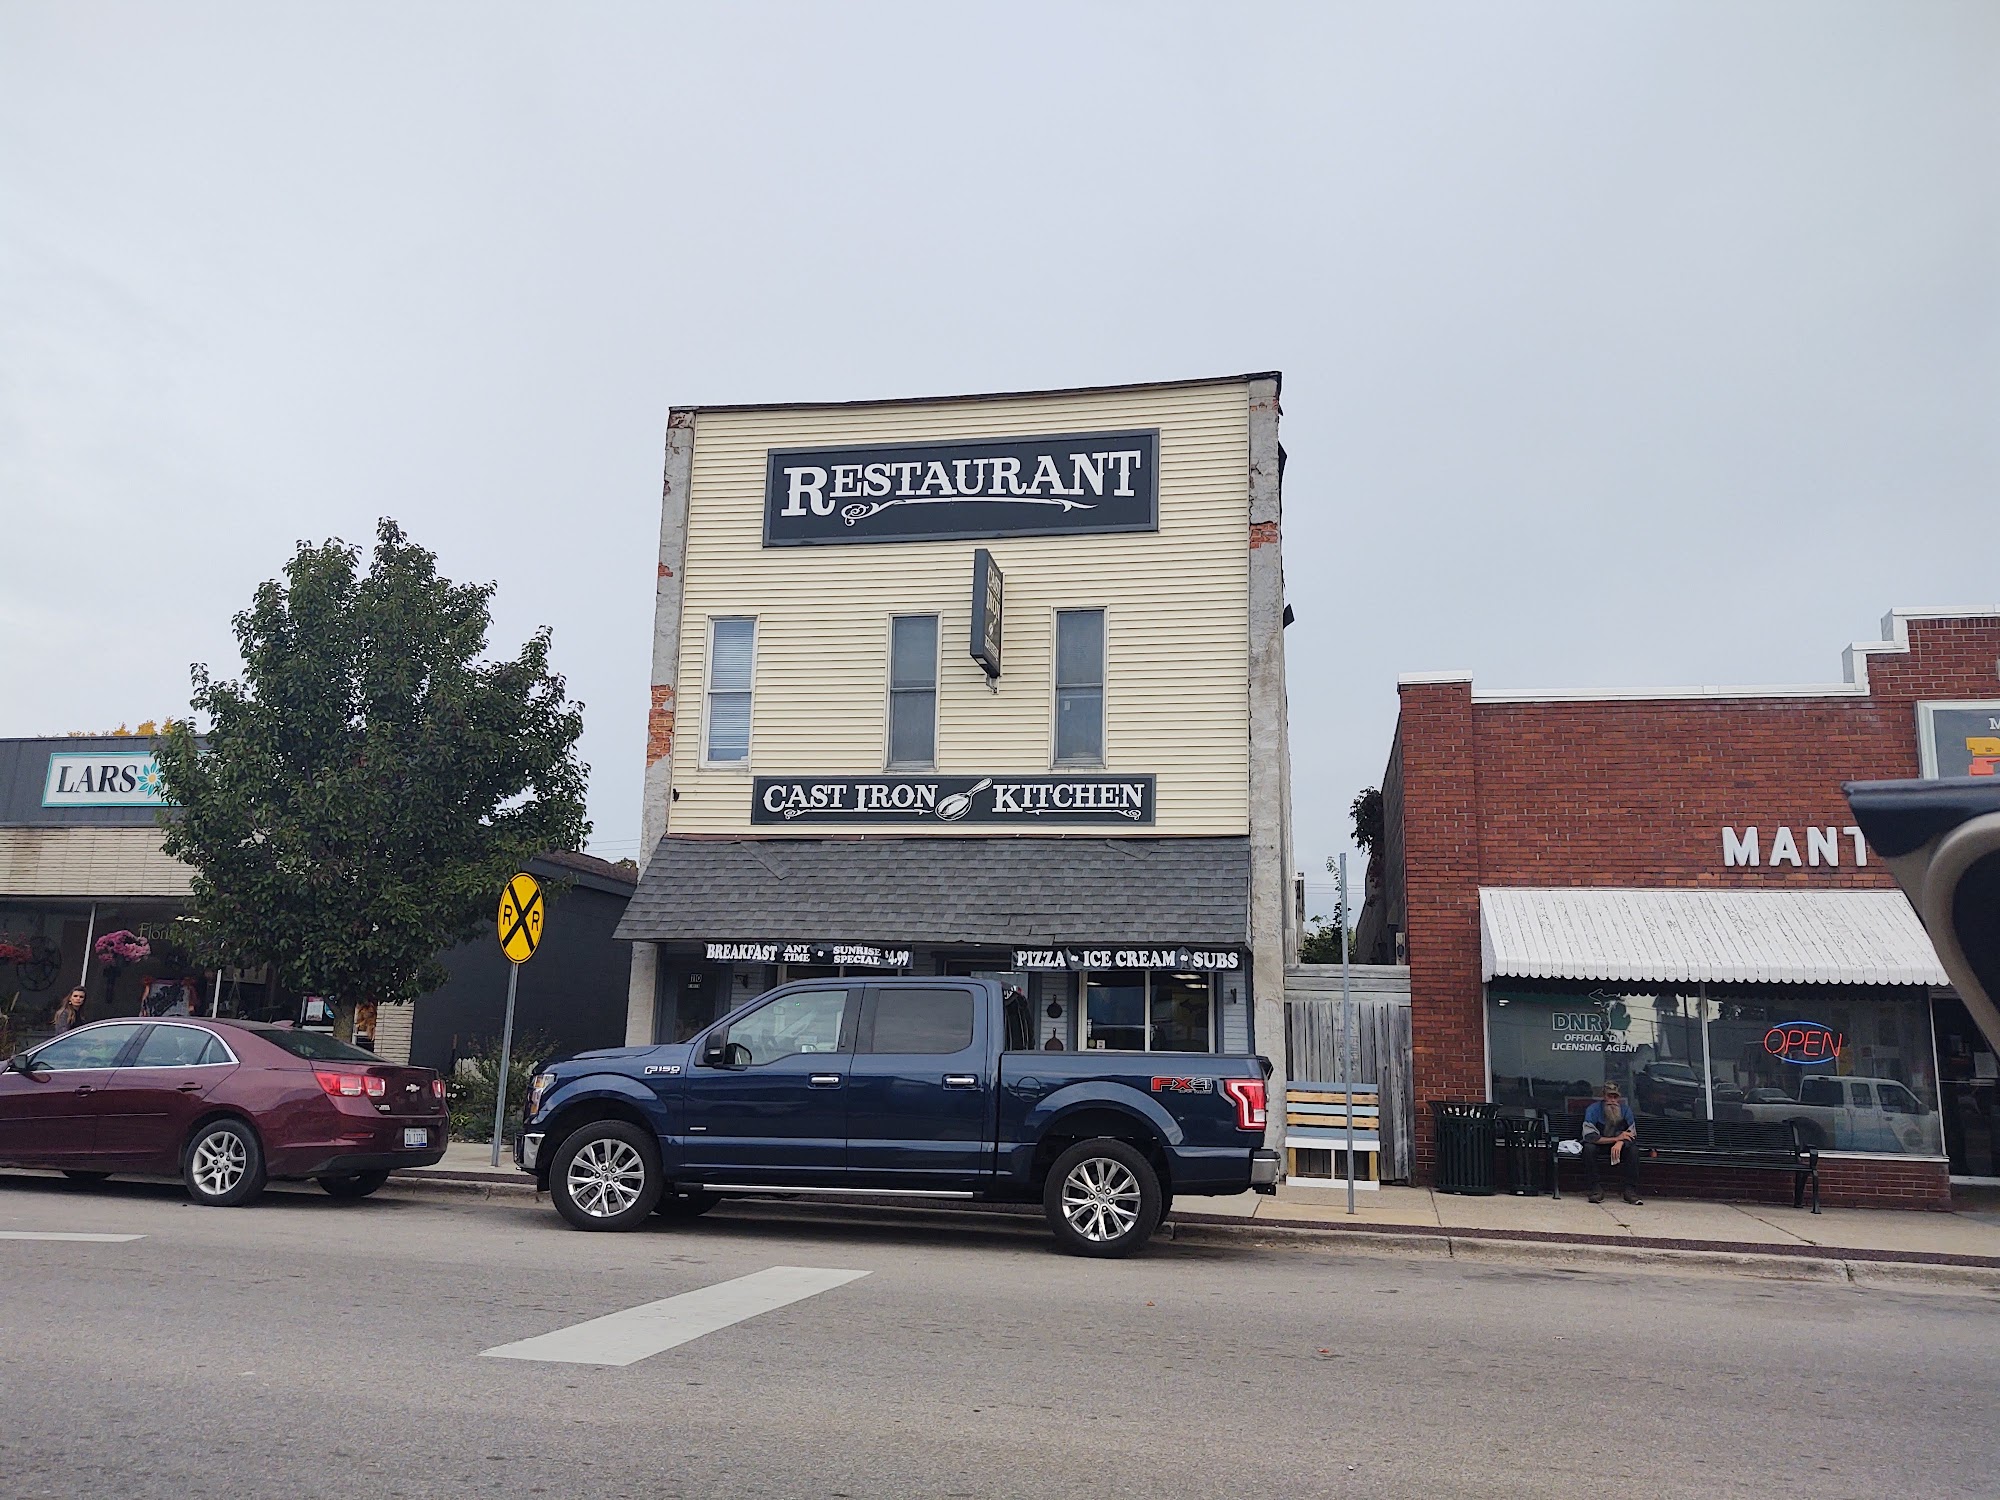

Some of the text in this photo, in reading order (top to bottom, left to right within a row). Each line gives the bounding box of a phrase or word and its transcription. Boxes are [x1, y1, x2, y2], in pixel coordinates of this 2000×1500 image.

[780, 450, 1142, 517] RESTAURANT
[763, 783, 1145, 812] CAST IRON KITCHEN
[706, 943, 778, 961] BREAKFAST
[783, 953, 811, 962] TIME
[784, 944, 811, 954] ANY
[832, 945, 881, 956] SUNRISE
[884, 949, 909, 966] $4.99
[833, 955, 881, 966] SPECIAL
[1016, 950, 1066, 968] PIZZA
[1083, 950, 1112, 967] ICE
[1115, 950, 1176, 968] CREAM
[1192, 951, 1239, 969] SUBS
[1553, 1012, 1602, 1032] DNR
[1564, 1033, 1606, 1043] OFFICIAL
[1764, 1028, 1843, 1057] OPEN
[1551, 1042, 1639, 1053] LICENSING AGENT
[1151, 1076, 1213, 1093] FX4
